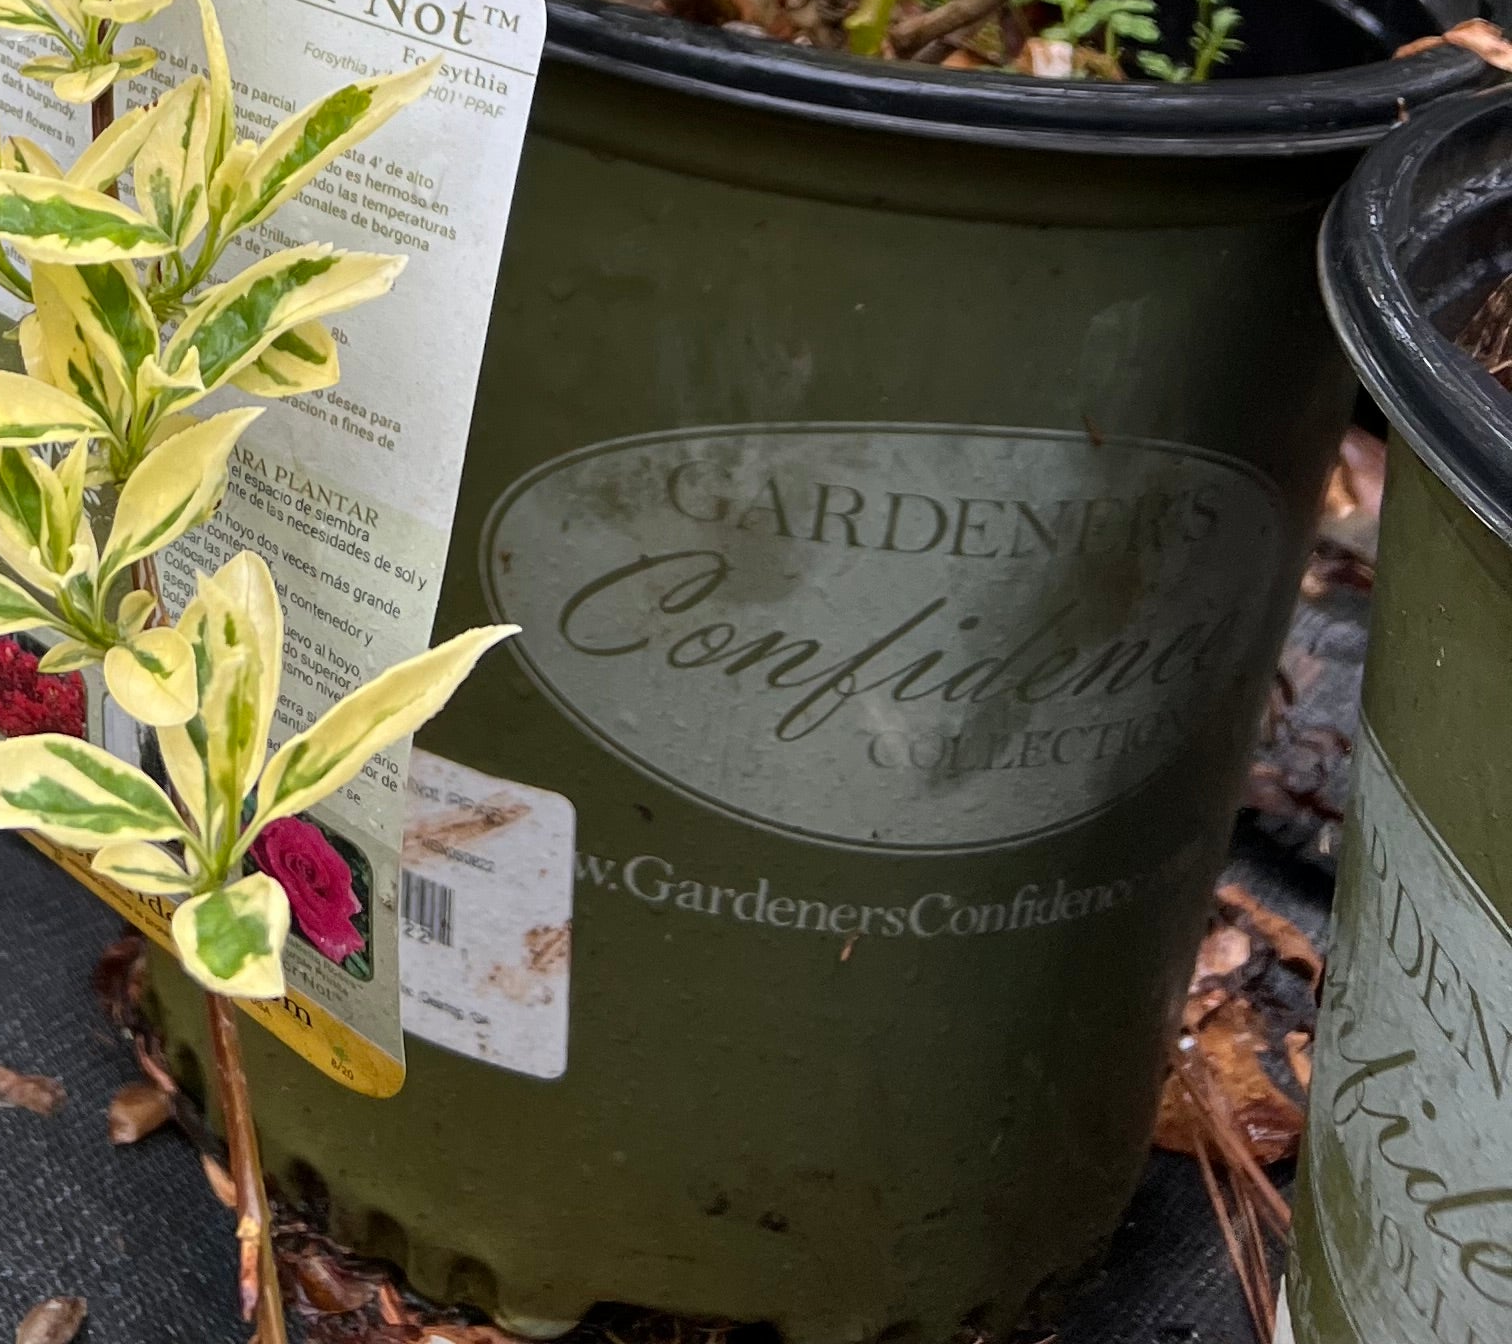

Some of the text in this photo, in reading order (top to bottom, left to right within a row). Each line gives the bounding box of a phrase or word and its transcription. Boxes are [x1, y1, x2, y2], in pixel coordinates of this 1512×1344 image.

[304, 41, 368, 76] Forsythia
[402, 45, 509, 96] Fosythia
[1, 72, 24, 94] dark
[26, 83, 76, 121] burgundy.
[128, 77, 150, 97] por
[190, 62, 199, 75] a
[251, 87, 297, 113] parcial
[464, 96, 507, 119] PPAF
[25, 110, 63, 141] flowers
[65, 130, 76, 148] in
[345, 169, 449, 217] es hermoso en
[368, 156, 434, 190] 4' de alto
[338, 186, 457, 241] las temperaturas
[351, 211, 368, 229] de
[370, 220, 431, 252] borgona
[244, 238, 261, 255] de
[327, 389, 367, 420] desea
[369, 410, 402, 435] para
[329, 413, 396, 451] a fines de
[231, 464, 370, 543] el espacio de siembra
[274, 464, 380, 529] PLANTAR
[666, 458, 1220, 560] GARDENER'S
[203, 538, 221, 559] las
[249, 491, 428, 593] de las necesidades de sol y
[225, 511, 256, 542] hoyo
[257, 532, 279, 556] dos
[281, 549, 317, 580] veces
[320, 571, 350, 595] más
[353, 584, 402, 620] grande
[161, 582, 187, 611] bola
[290, 591, 376, 649] contenedor y
[300, 652, 353, 692] superior
[314, 639, 326, 659] al
[328, 646, 363, 683] hoyo,
[346, 788, 362, 806] se
[381, 773, 399, 794] de
